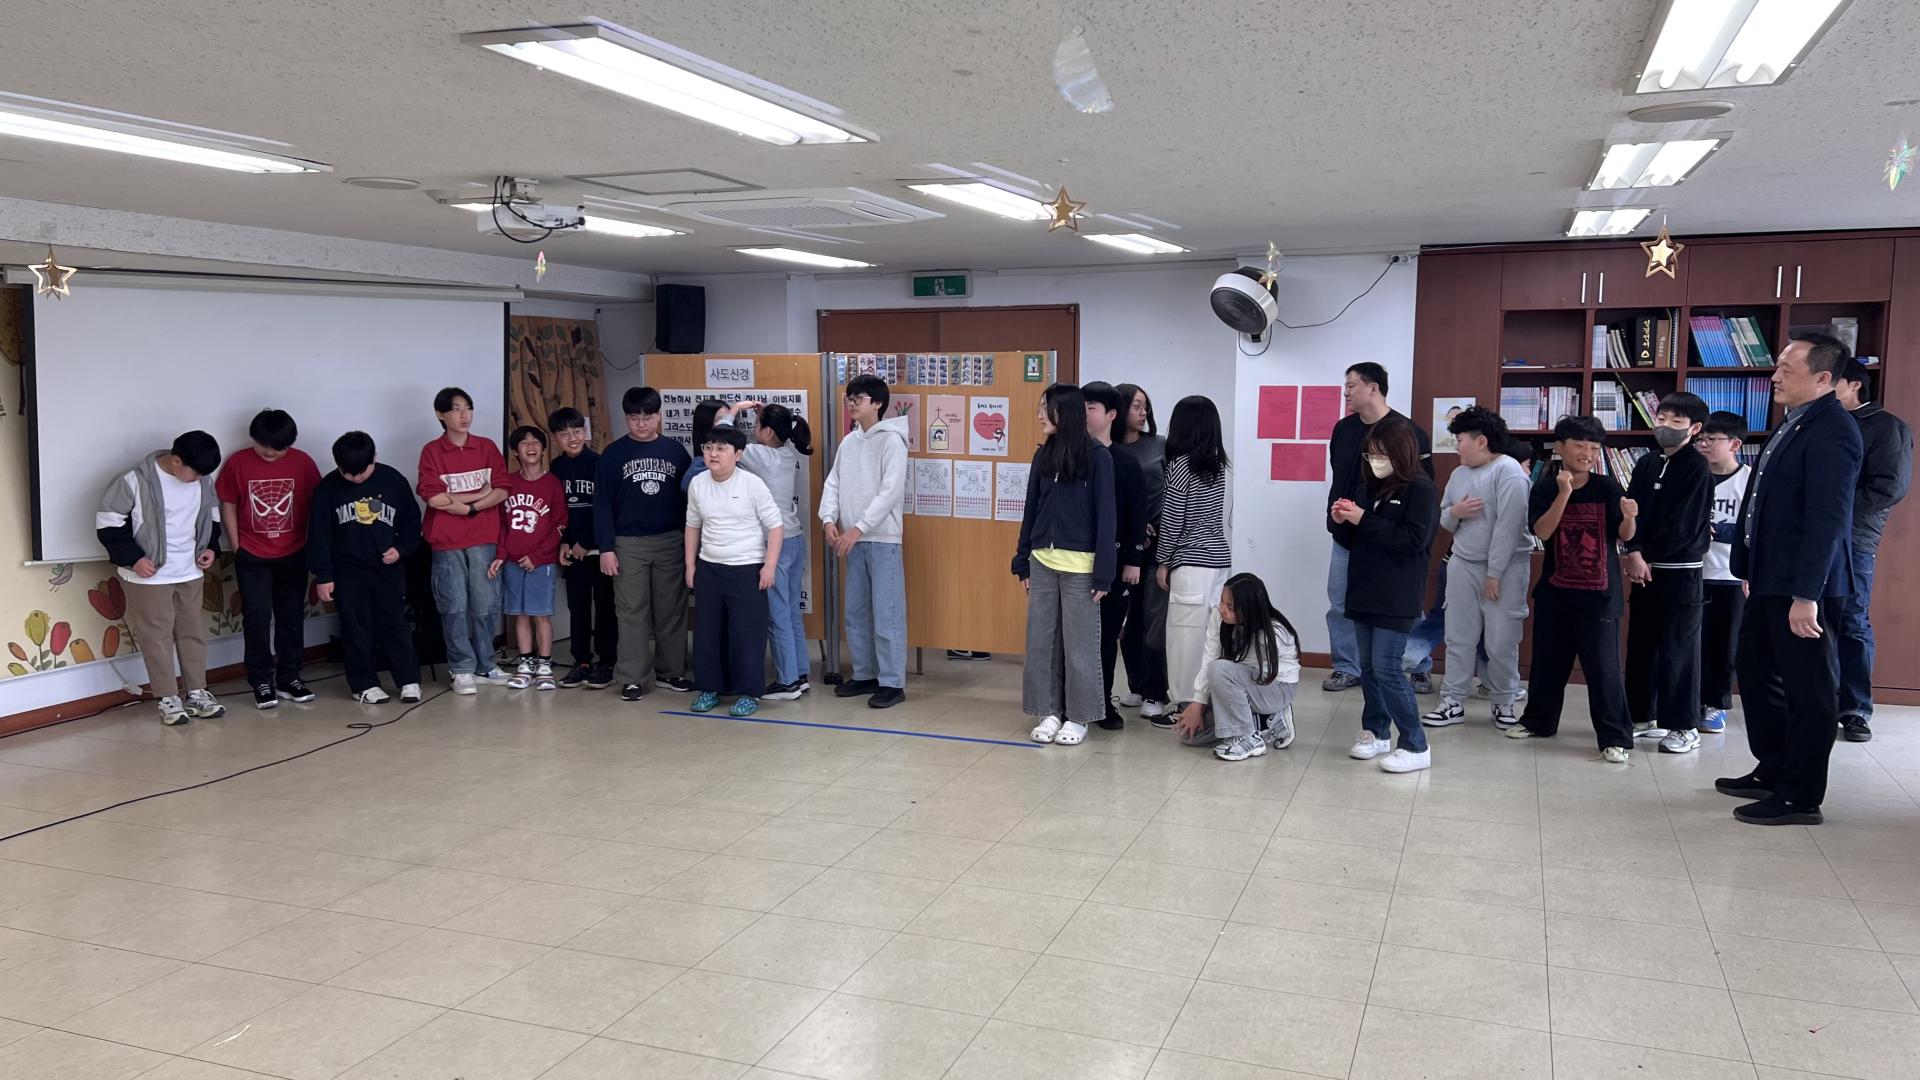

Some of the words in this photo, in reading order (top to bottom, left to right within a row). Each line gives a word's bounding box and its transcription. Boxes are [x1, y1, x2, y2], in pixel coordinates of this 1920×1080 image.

[710, 368, 750, 381] 사도신경
[663, 394, 691, 404] 전능하사
[719, 393, 742, 402] 만드신
[745, 394, 769, 403] 하나님
[773, 394, 802, 404] 아버지를
[666, 409, 680, 418] 내가
[622, 457, 677, 475] ENCOURAGE
[632, 469, 667, 483] SOMEDAY
[504, 493, 551, 516] JORDAN
[1713, 498, 1736, 518] TH
[511, 509, 539, 534] 23
